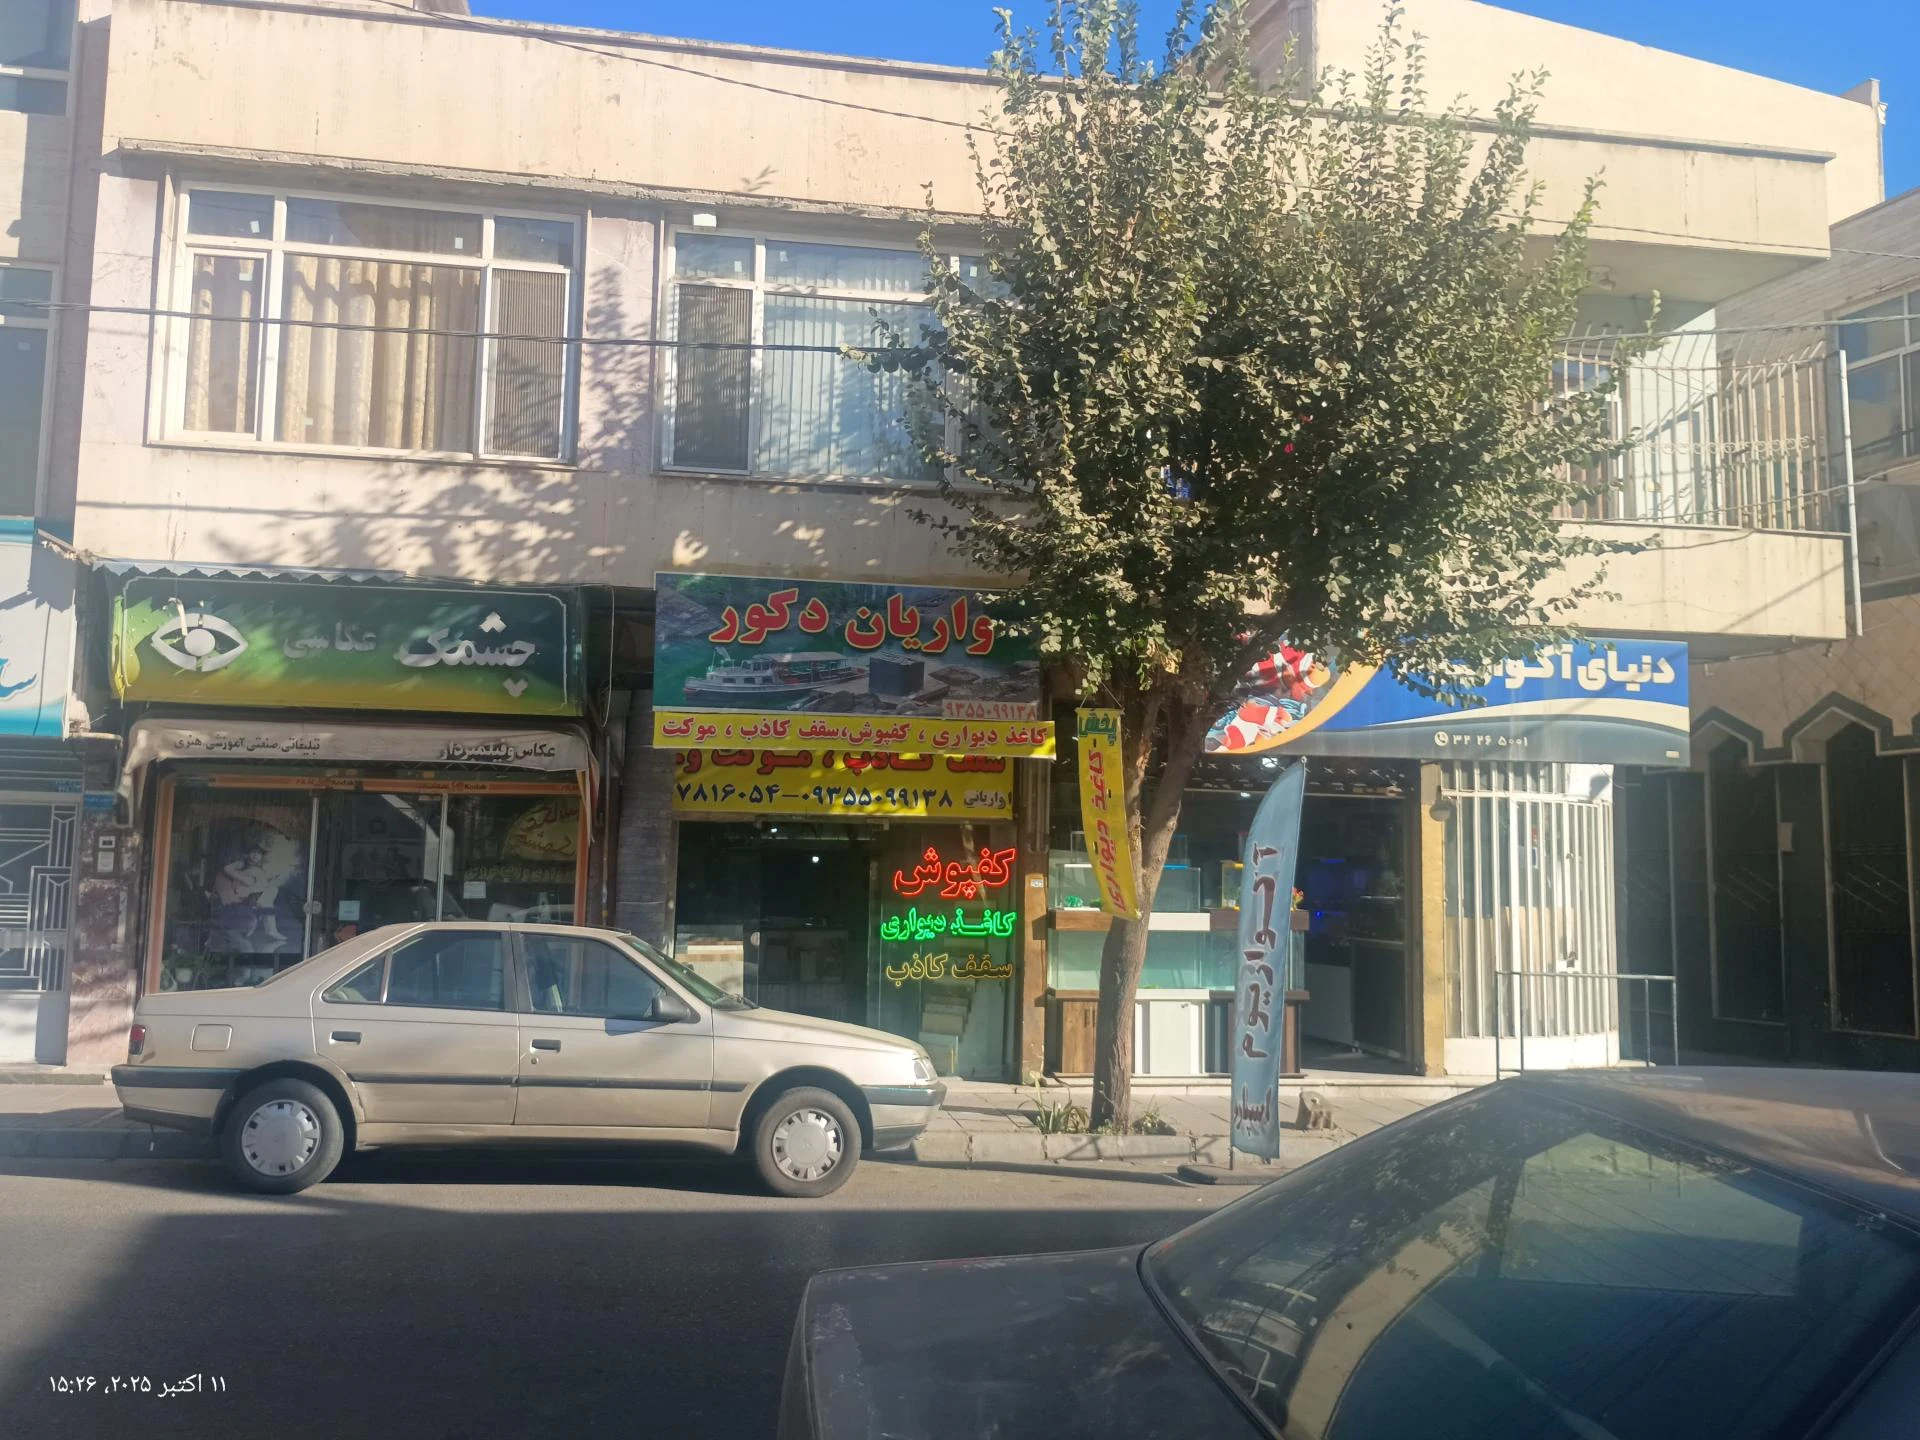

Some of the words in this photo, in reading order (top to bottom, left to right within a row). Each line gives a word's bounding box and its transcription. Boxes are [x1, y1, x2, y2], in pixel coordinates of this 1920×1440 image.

[708, 588, 830, 644] دکور
[845, 593, 997, 655] واریان
[283, 621, 377, 659] عکاسی
[393, 610, 536, 699] چشمک
[1576, 648, 1677, 693] دنیای
[661, 717, 717, 743] موکت
[739, 717, 791, 743] کاذب
[798, 718, 840, 739] سقف
[931, 724, 999, 749] دیواری
[1005, 725, 1049, 747] کاغذ
[1497, 735, 1529, 748] ۵۰۰۱
[515, 741, 557, 760] عکاس
[1088, 749, 1107, 812] کاغذ
[894, 847, 1016, 899] کفپوش
[1096, 818, 1127, 913] دیواری
[880, 906, 947, 941] دیواری
[950, 907, 1016, 937] کاغذ
[951, 953, 1013, 980] سقف
[1240, 842, 1280, 1060] آکواریوم
[886, 952, 949, 987] کاذب
